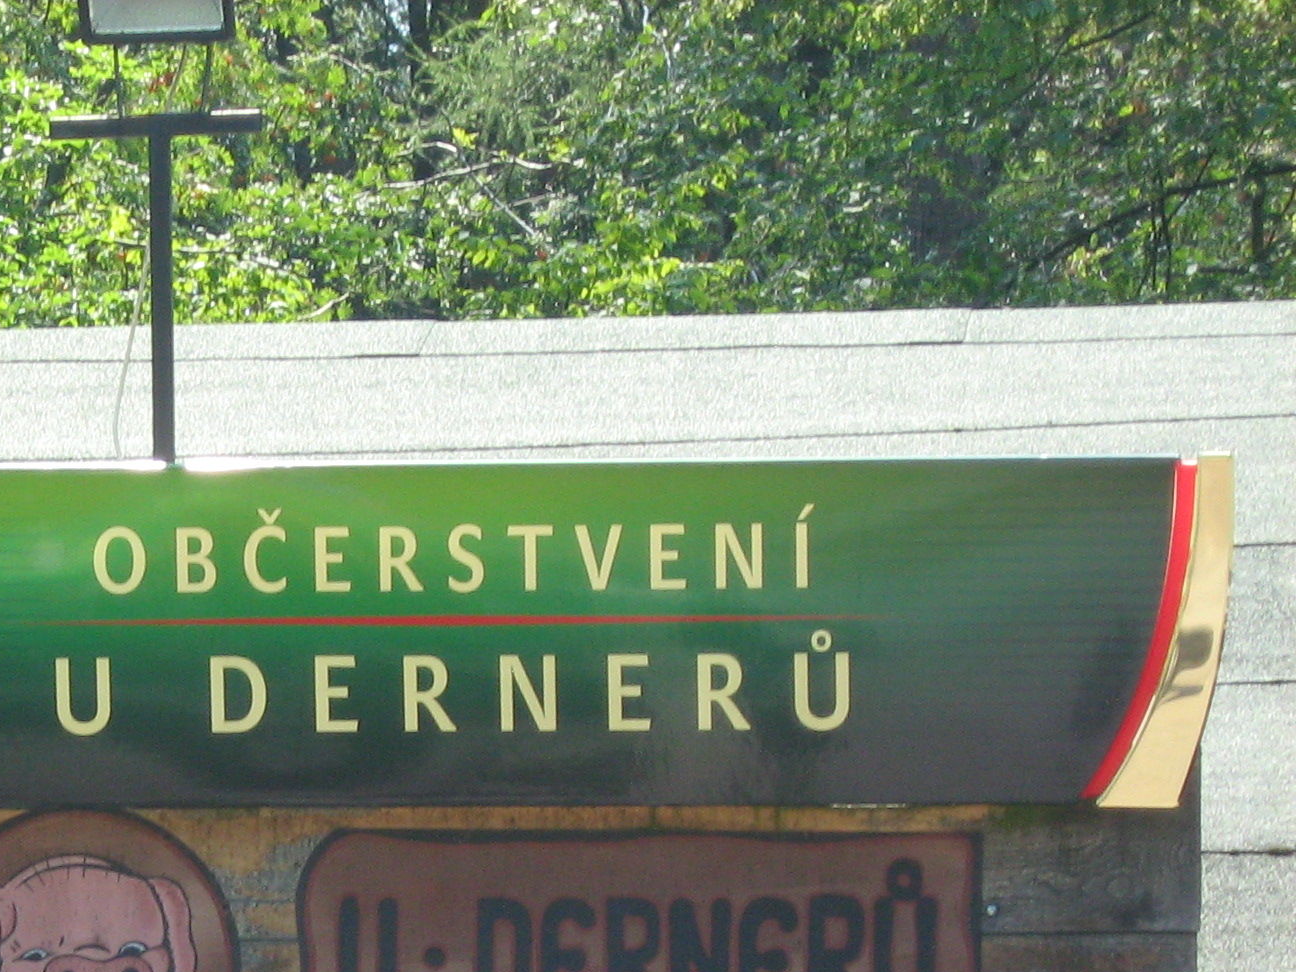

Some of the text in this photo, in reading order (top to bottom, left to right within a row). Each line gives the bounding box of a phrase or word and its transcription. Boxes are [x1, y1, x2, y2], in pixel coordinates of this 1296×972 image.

[92, 503, 815, 598] OBČERSTVENÍ
[53, 628, 852, 738] U DERNERŮ
